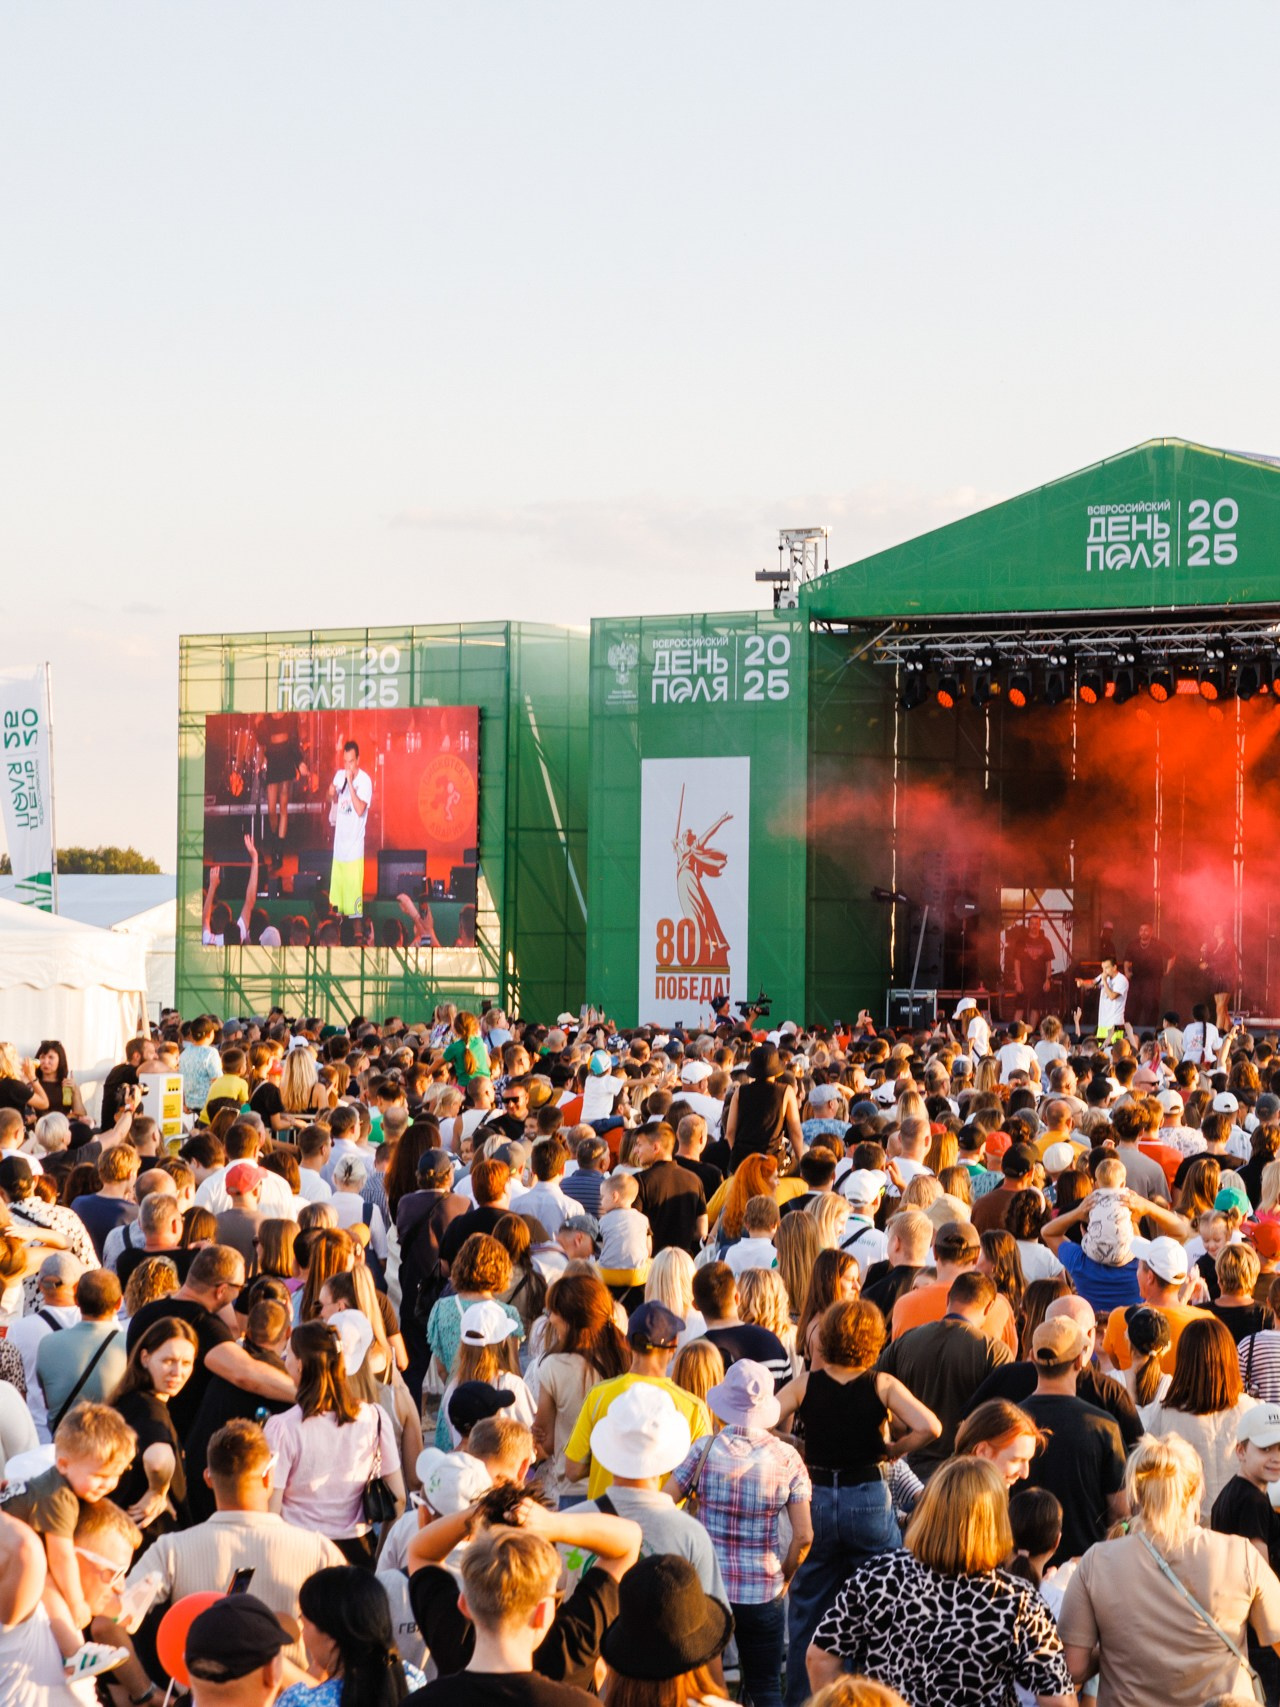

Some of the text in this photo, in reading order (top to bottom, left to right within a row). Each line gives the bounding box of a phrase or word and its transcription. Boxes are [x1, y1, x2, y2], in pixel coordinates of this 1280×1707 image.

[1087, 499, 1171, 516] ВСЕРОССИЙСКИЙ
[1188, 497, 1239, 531] 20
[1086, 513, 1171, 544] ДЕНЬ
[1086, 541, 1170, 572] ПОЛЯ
[1187, 533, 1239, 567] 25
[653, 635, 729, 649] ВСЕРОССИЙСКИЙ
[744, 634, 791, 666] 20
[278, 658, 346, 684] ДЕНЬ
[360, 645, 400, 675] 20
[652, 649, 728, 676] ДЕНЬ
[278, 684, 346, 709] ПОЛЯ
[359, 678, 399, 708] 25
[651, 675, 728, 704] ПОЛЯ
[743, 669, 790, 702] 25
[656, 917, 696, 965] 80
